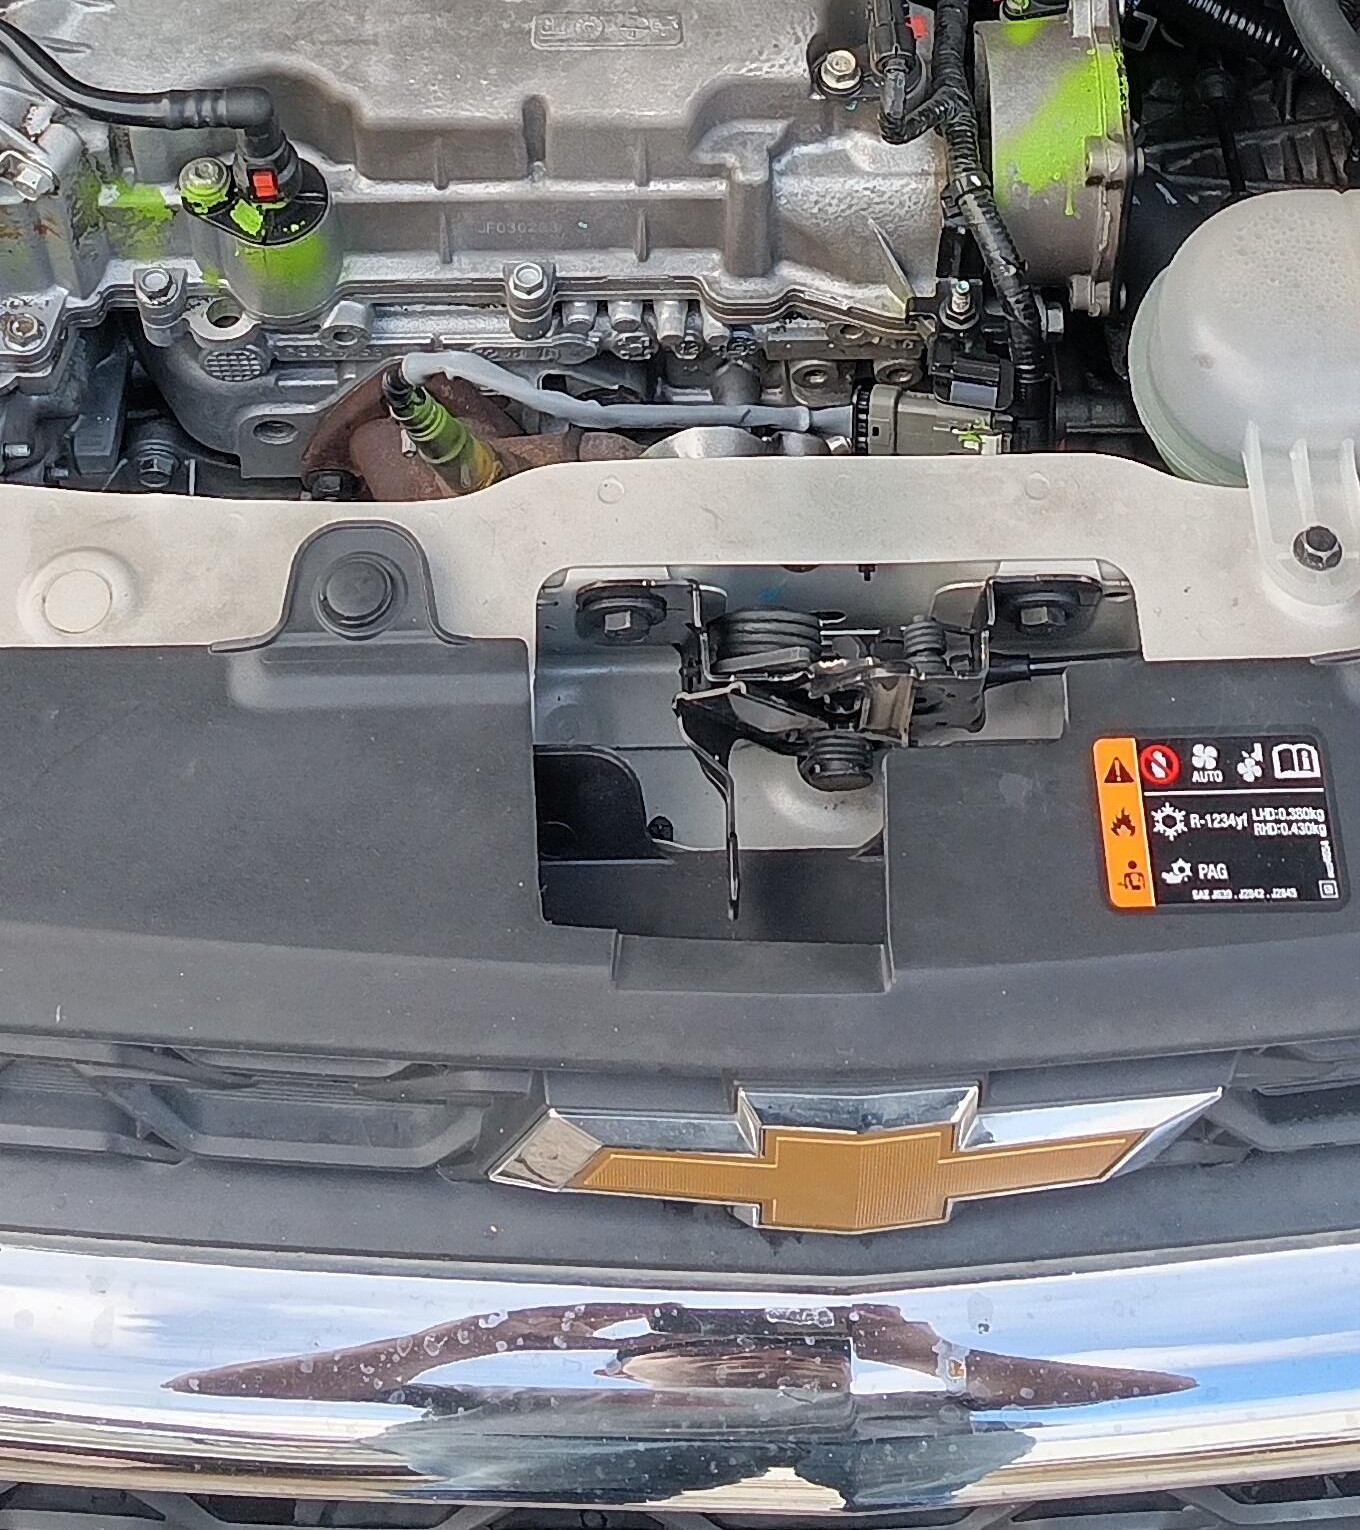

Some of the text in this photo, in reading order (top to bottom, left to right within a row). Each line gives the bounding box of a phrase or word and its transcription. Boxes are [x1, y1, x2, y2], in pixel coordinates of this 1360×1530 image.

[1192, 771, 1223, 783] AUTO
[1190, 812, 1248, 831] R-1234yf
[1198, 863, 1229, 880] PAG
